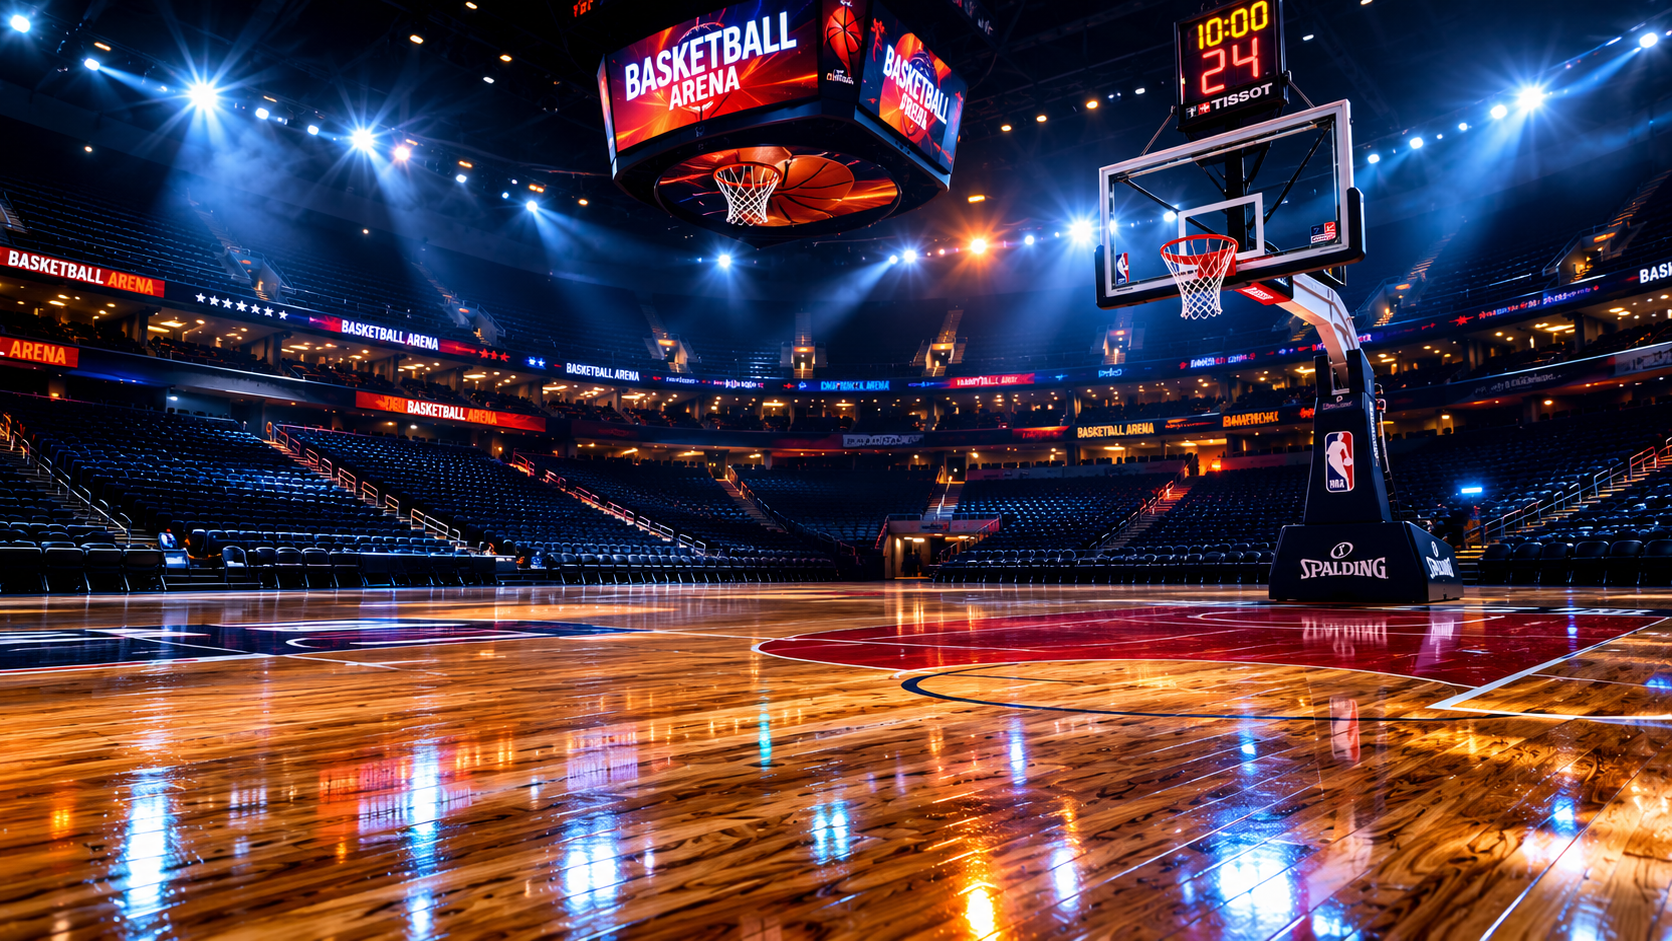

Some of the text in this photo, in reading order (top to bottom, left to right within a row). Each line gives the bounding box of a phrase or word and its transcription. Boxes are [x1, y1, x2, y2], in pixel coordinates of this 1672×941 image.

[1198, 1, 1268, 50] 10:00
[625, 11, 797, 102] BASKETBALL
[1202, 37, 1259, 94] 24
[669, 65, 740, 110] ARENA
[882, 44, 949, 125] BASKETBALL
[1211, 82, 1273, 109] TISSOT
[8, 250, 154, 295] BASKETBALL ARENA
[9, 341, 66, 364] ARENA
[341, 320, 439, 350] BASKETBALL ARENA
[407, 400, 466, 421] BASKETBALL
[1300, 557, 1389, 580] SPALDING
